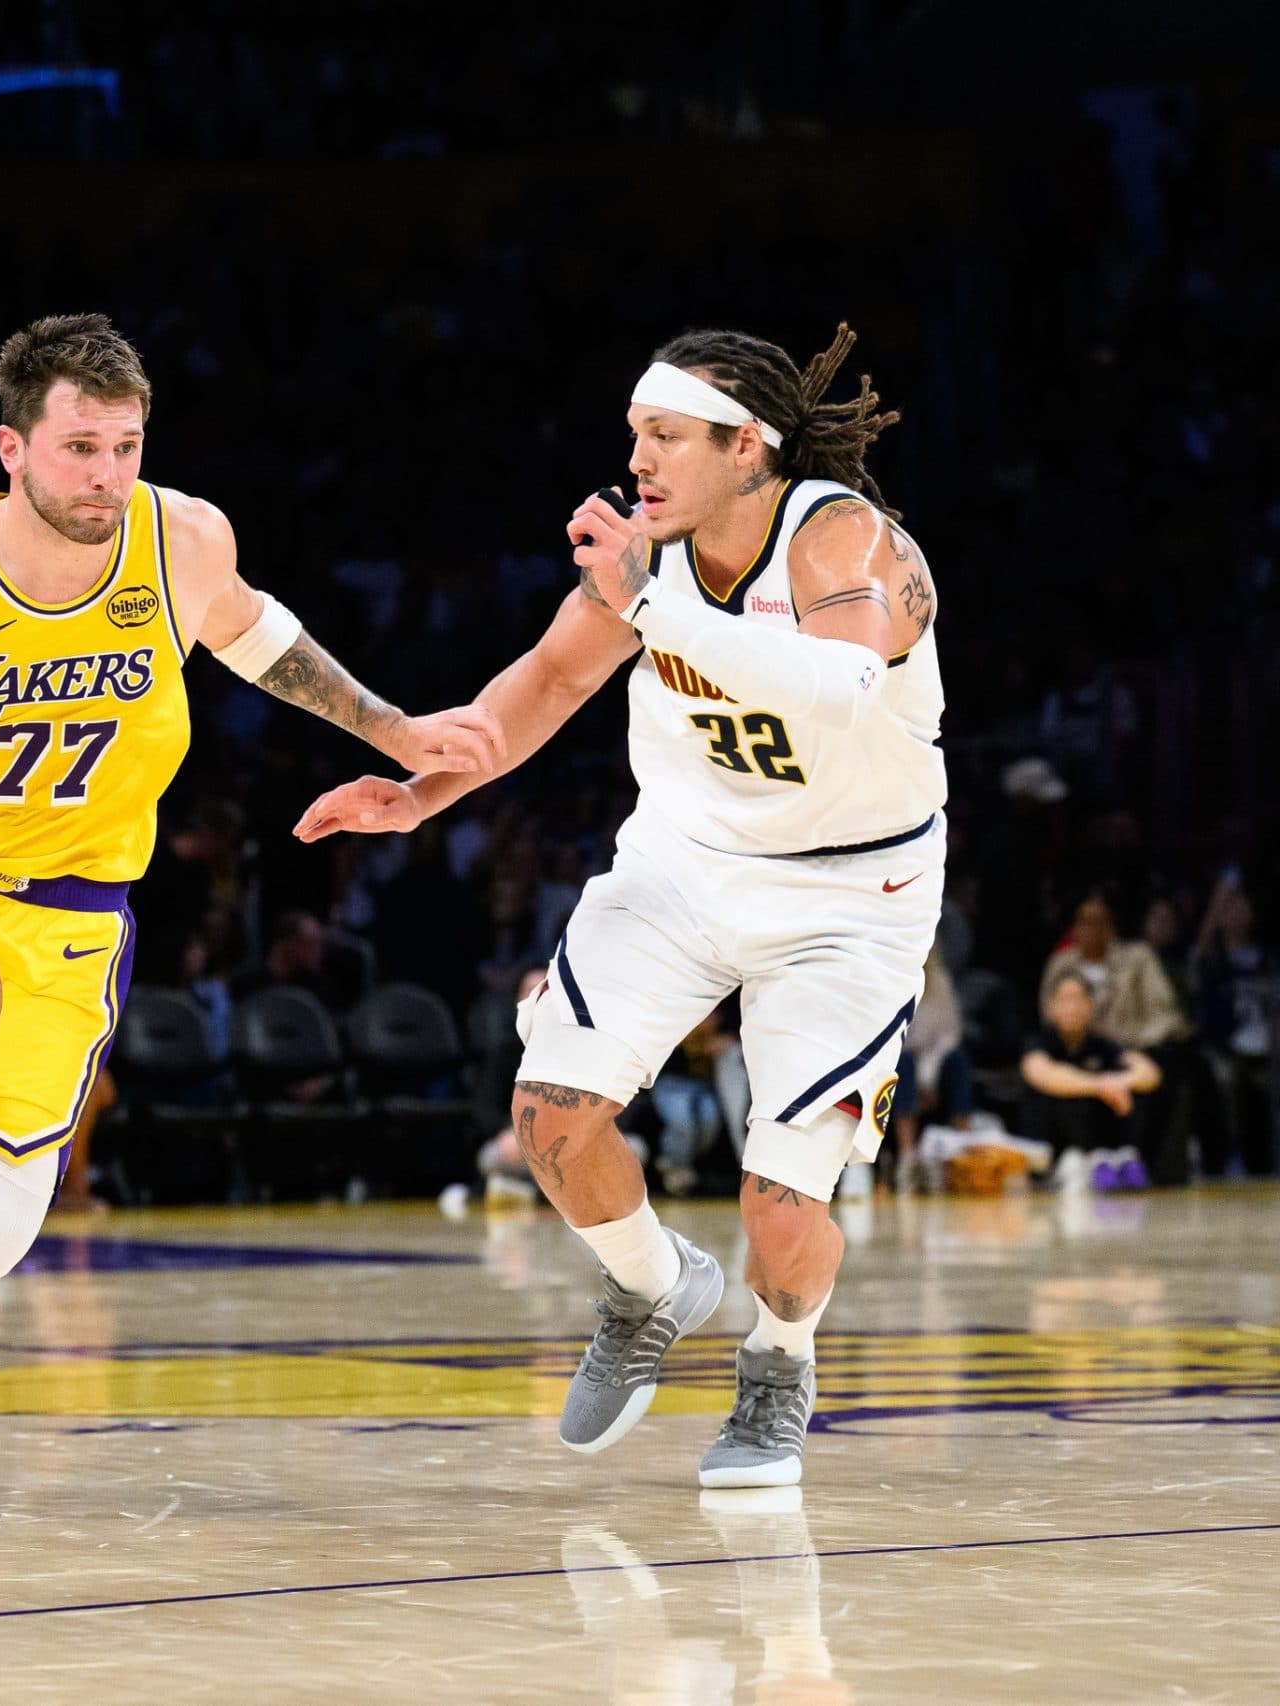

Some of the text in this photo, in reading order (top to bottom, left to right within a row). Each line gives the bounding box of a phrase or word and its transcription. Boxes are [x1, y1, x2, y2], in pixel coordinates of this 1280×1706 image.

[111, 597, 156, 615] bibigo
[751, 596, 791, 615] ibotta
[687, 711, 807, 787] 32
